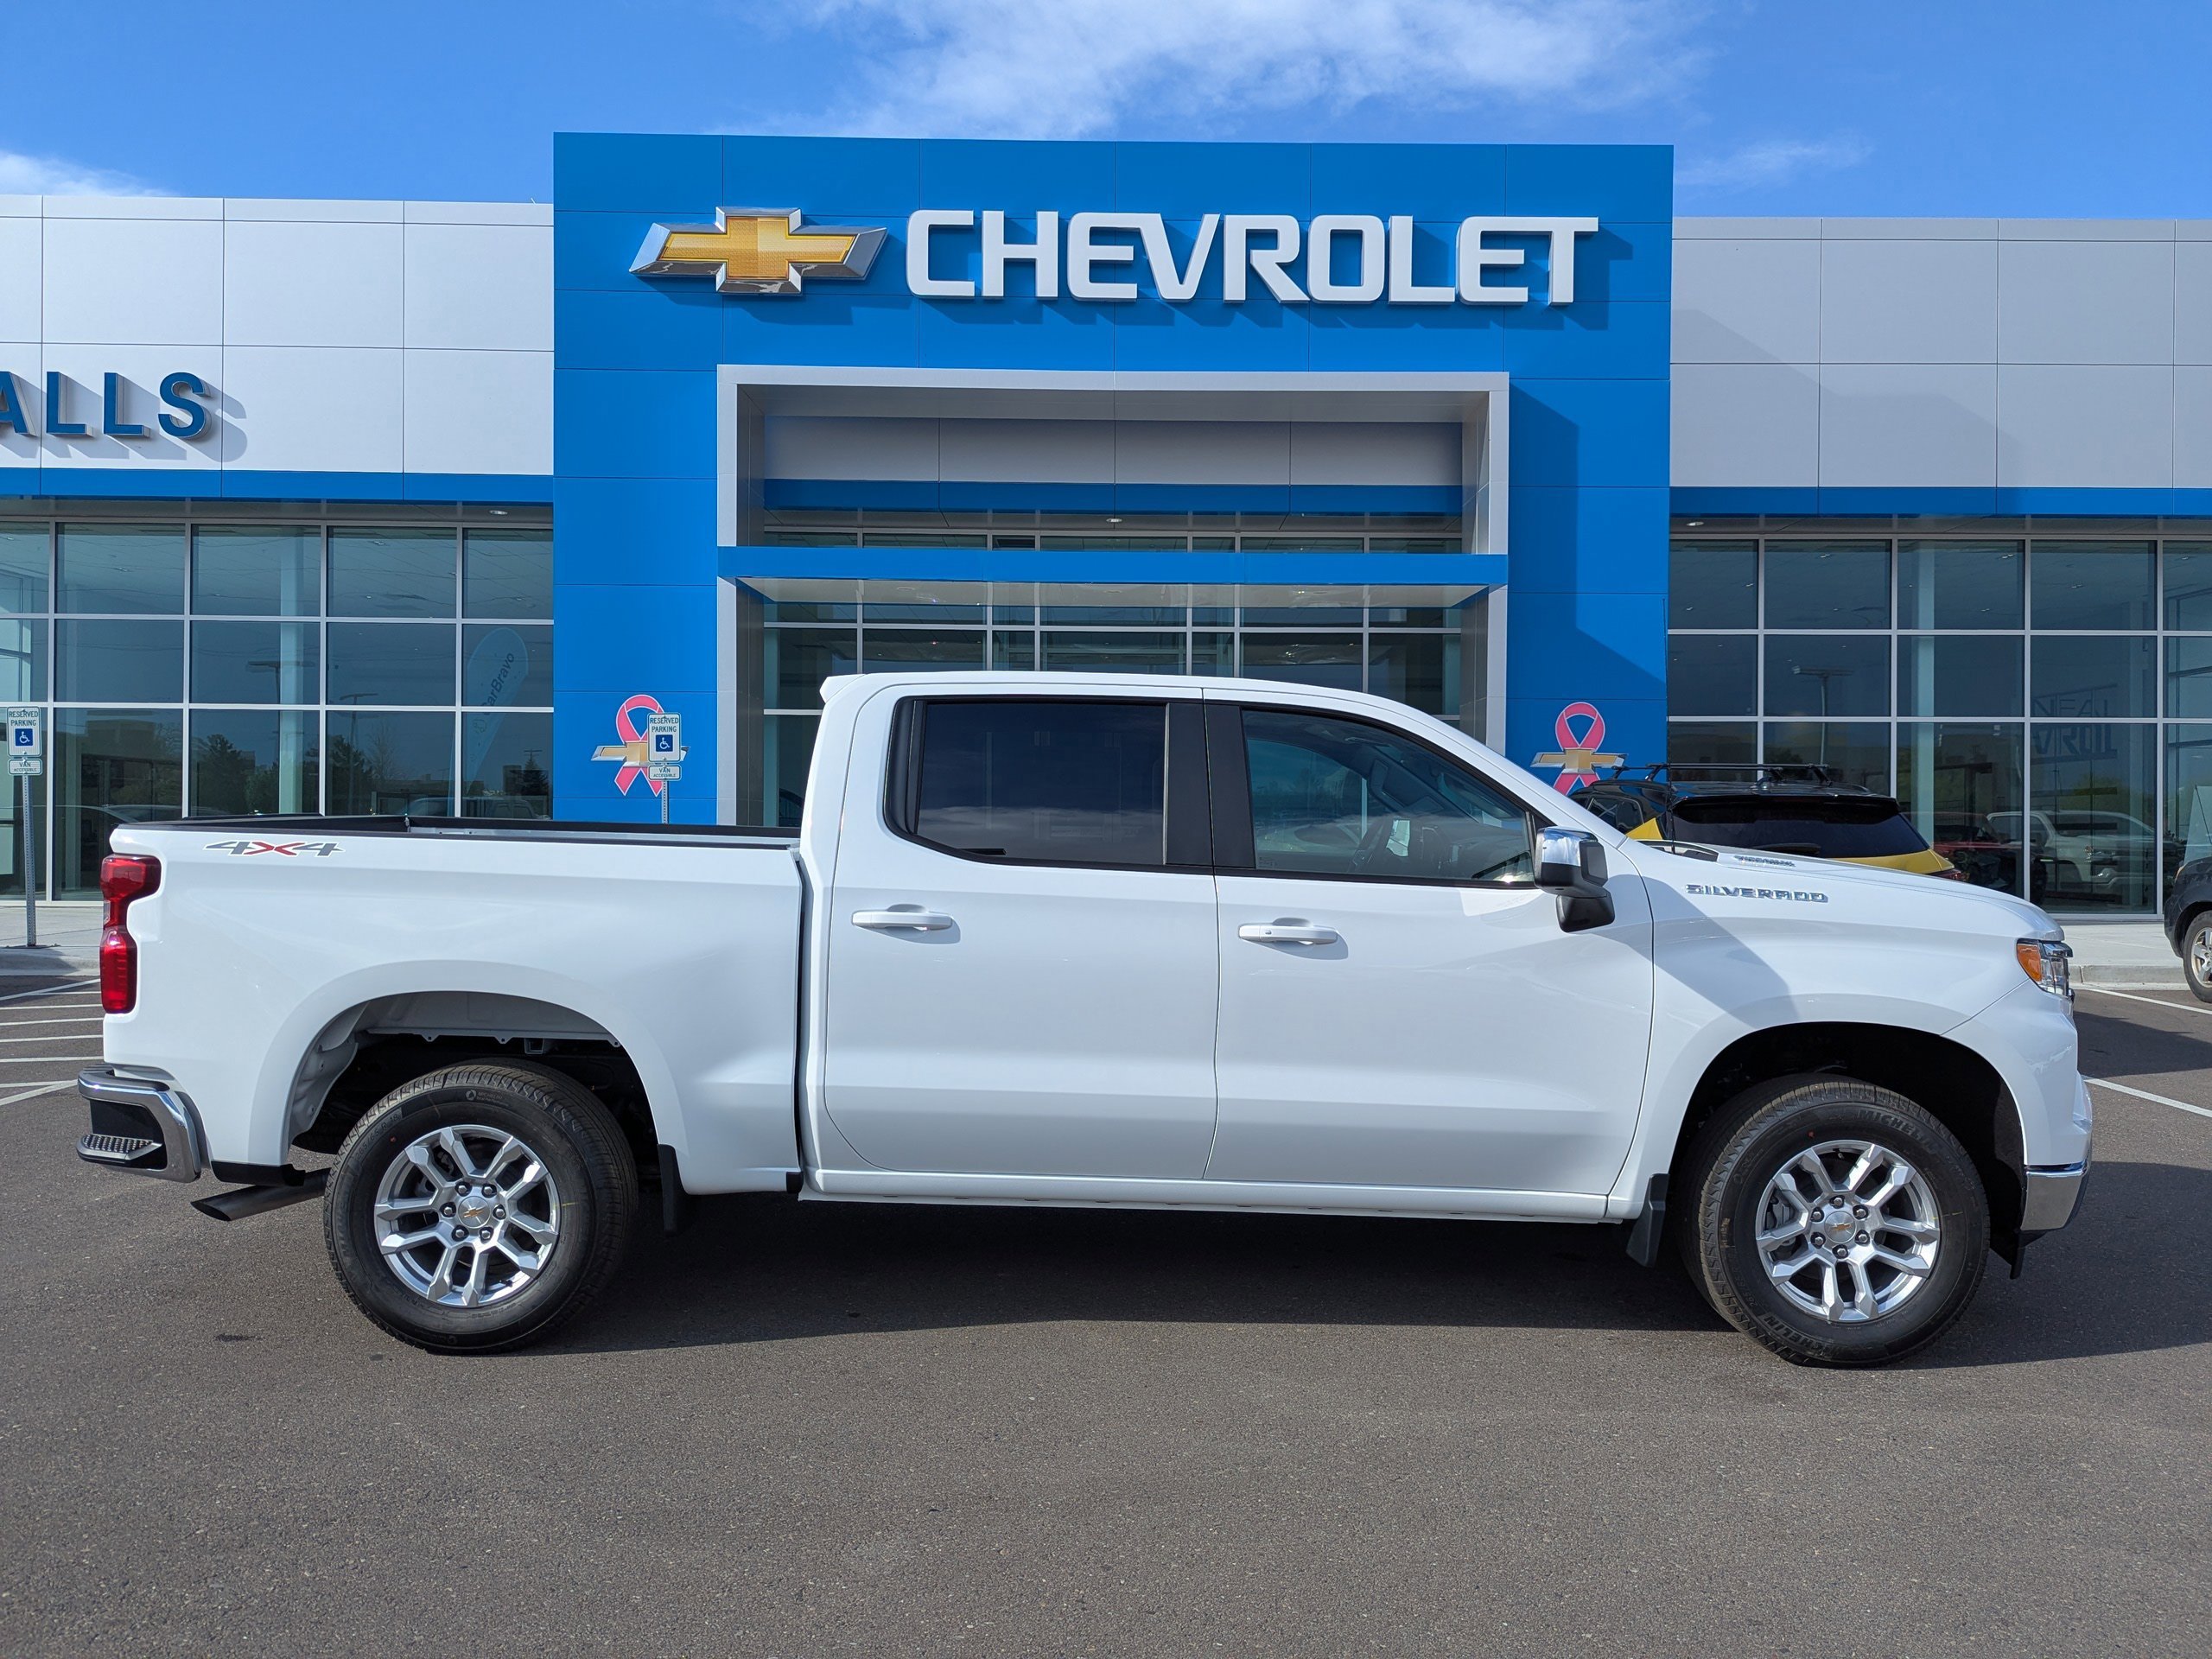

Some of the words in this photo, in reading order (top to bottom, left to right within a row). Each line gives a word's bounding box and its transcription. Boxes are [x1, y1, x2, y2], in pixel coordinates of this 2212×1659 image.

[906, 209, 1599, 306] CHEVROLET
[0, 371, 212, 439] ALLS
[1685, 883, 1828, 903] SILVERADO
